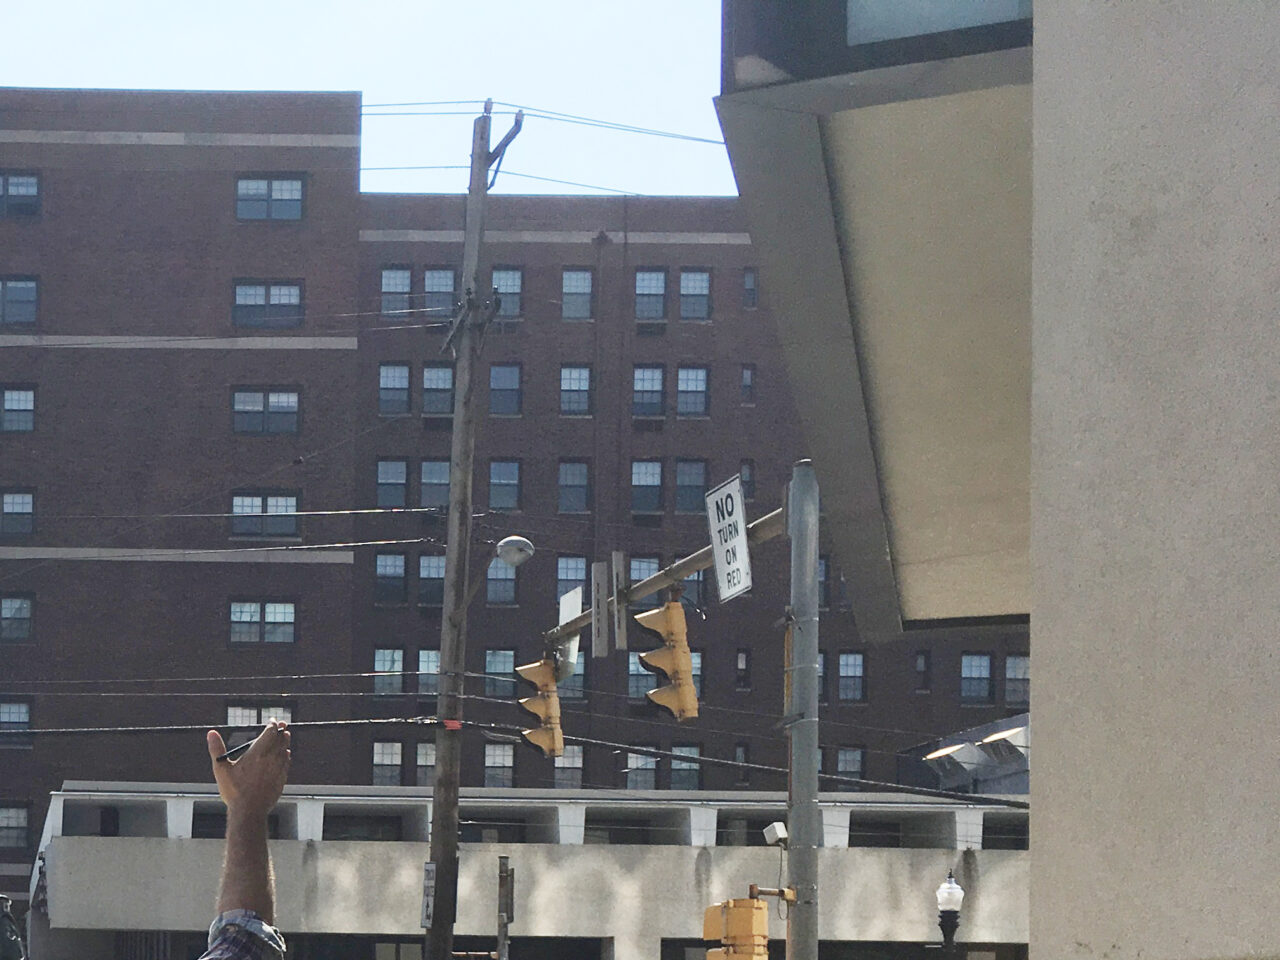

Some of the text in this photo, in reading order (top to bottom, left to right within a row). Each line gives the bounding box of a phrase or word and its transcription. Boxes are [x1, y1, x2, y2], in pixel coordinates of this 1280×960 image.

[715, 493, 734, 523] NO
[717, 520, 739, 545] TURN
[725, 549, 737, 565] ON
[726, 568, 741, 590] RED
